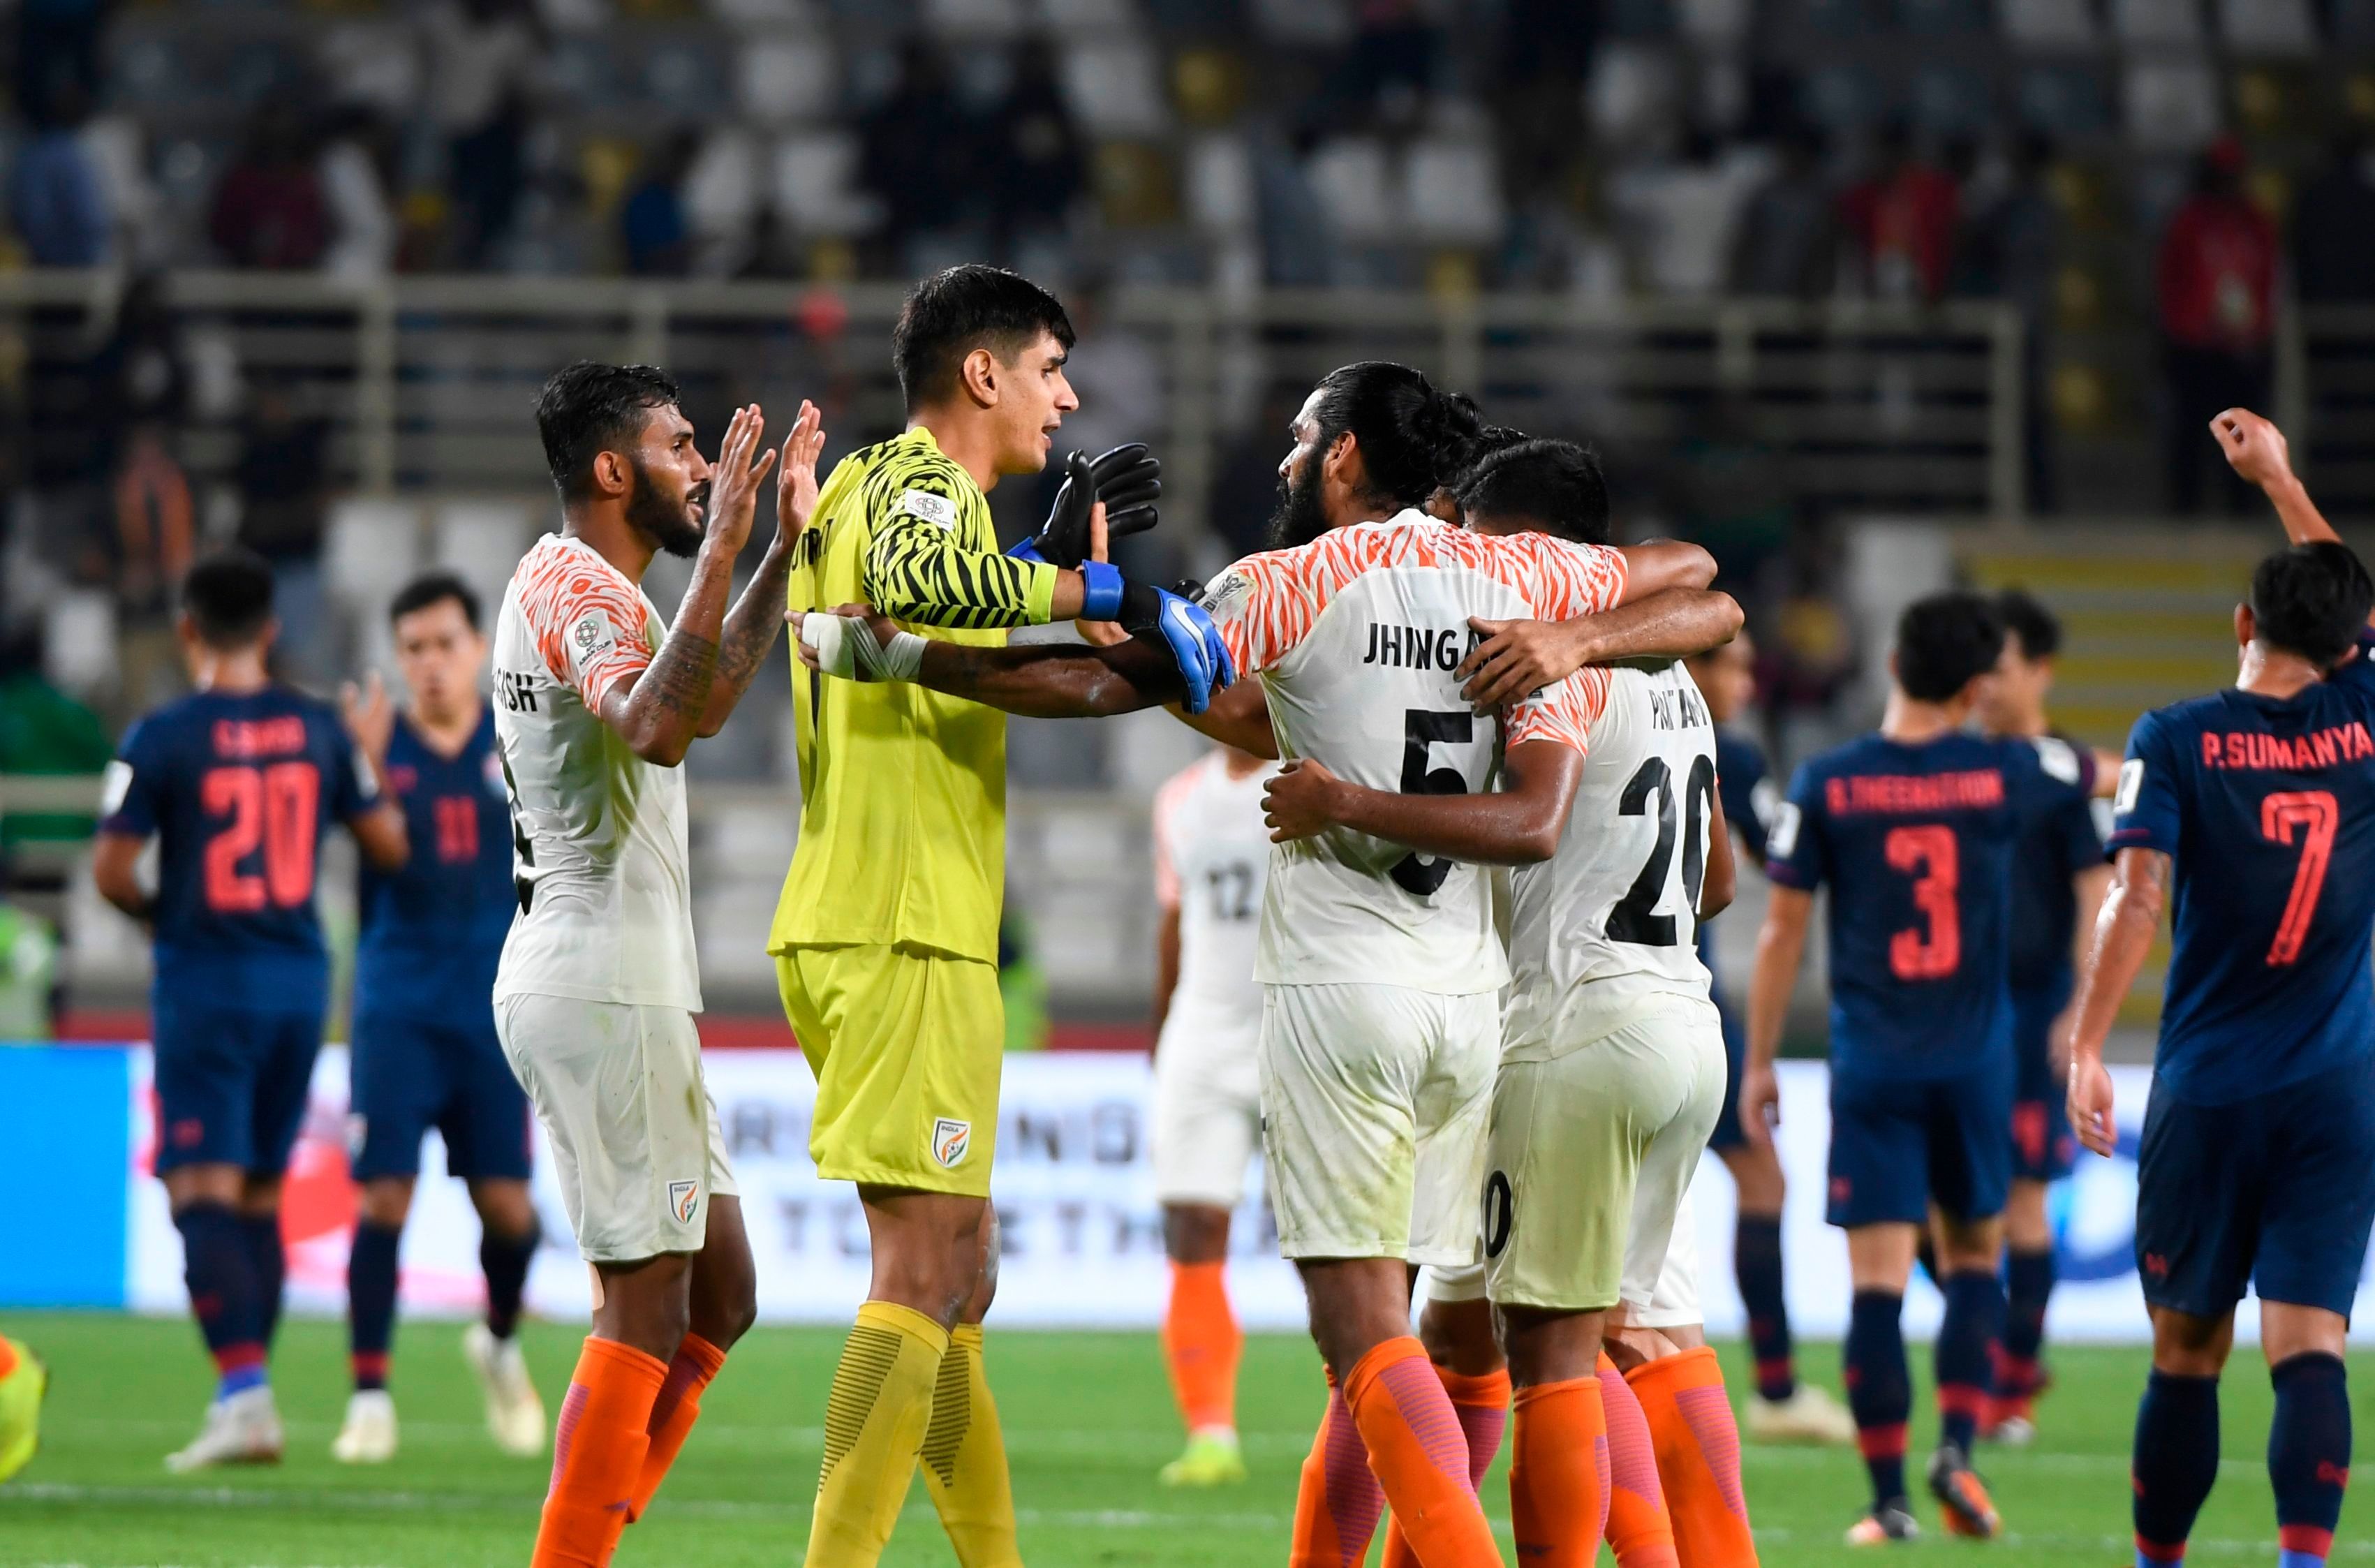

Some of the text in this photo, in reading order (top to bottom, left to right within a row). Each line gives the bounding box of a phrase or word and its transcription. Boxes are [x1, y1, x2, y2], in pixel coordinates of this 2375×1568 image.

[1390, 709, 1472, 896] 5
[2202, 721, 2374, 769] P.SUMANYA
[202, 763, 320, 912] 20
[1602, 753, 1715, 946] 20
[1885, 824, 1959, 979] 3
[2261, 790, 2339, 966] 7
